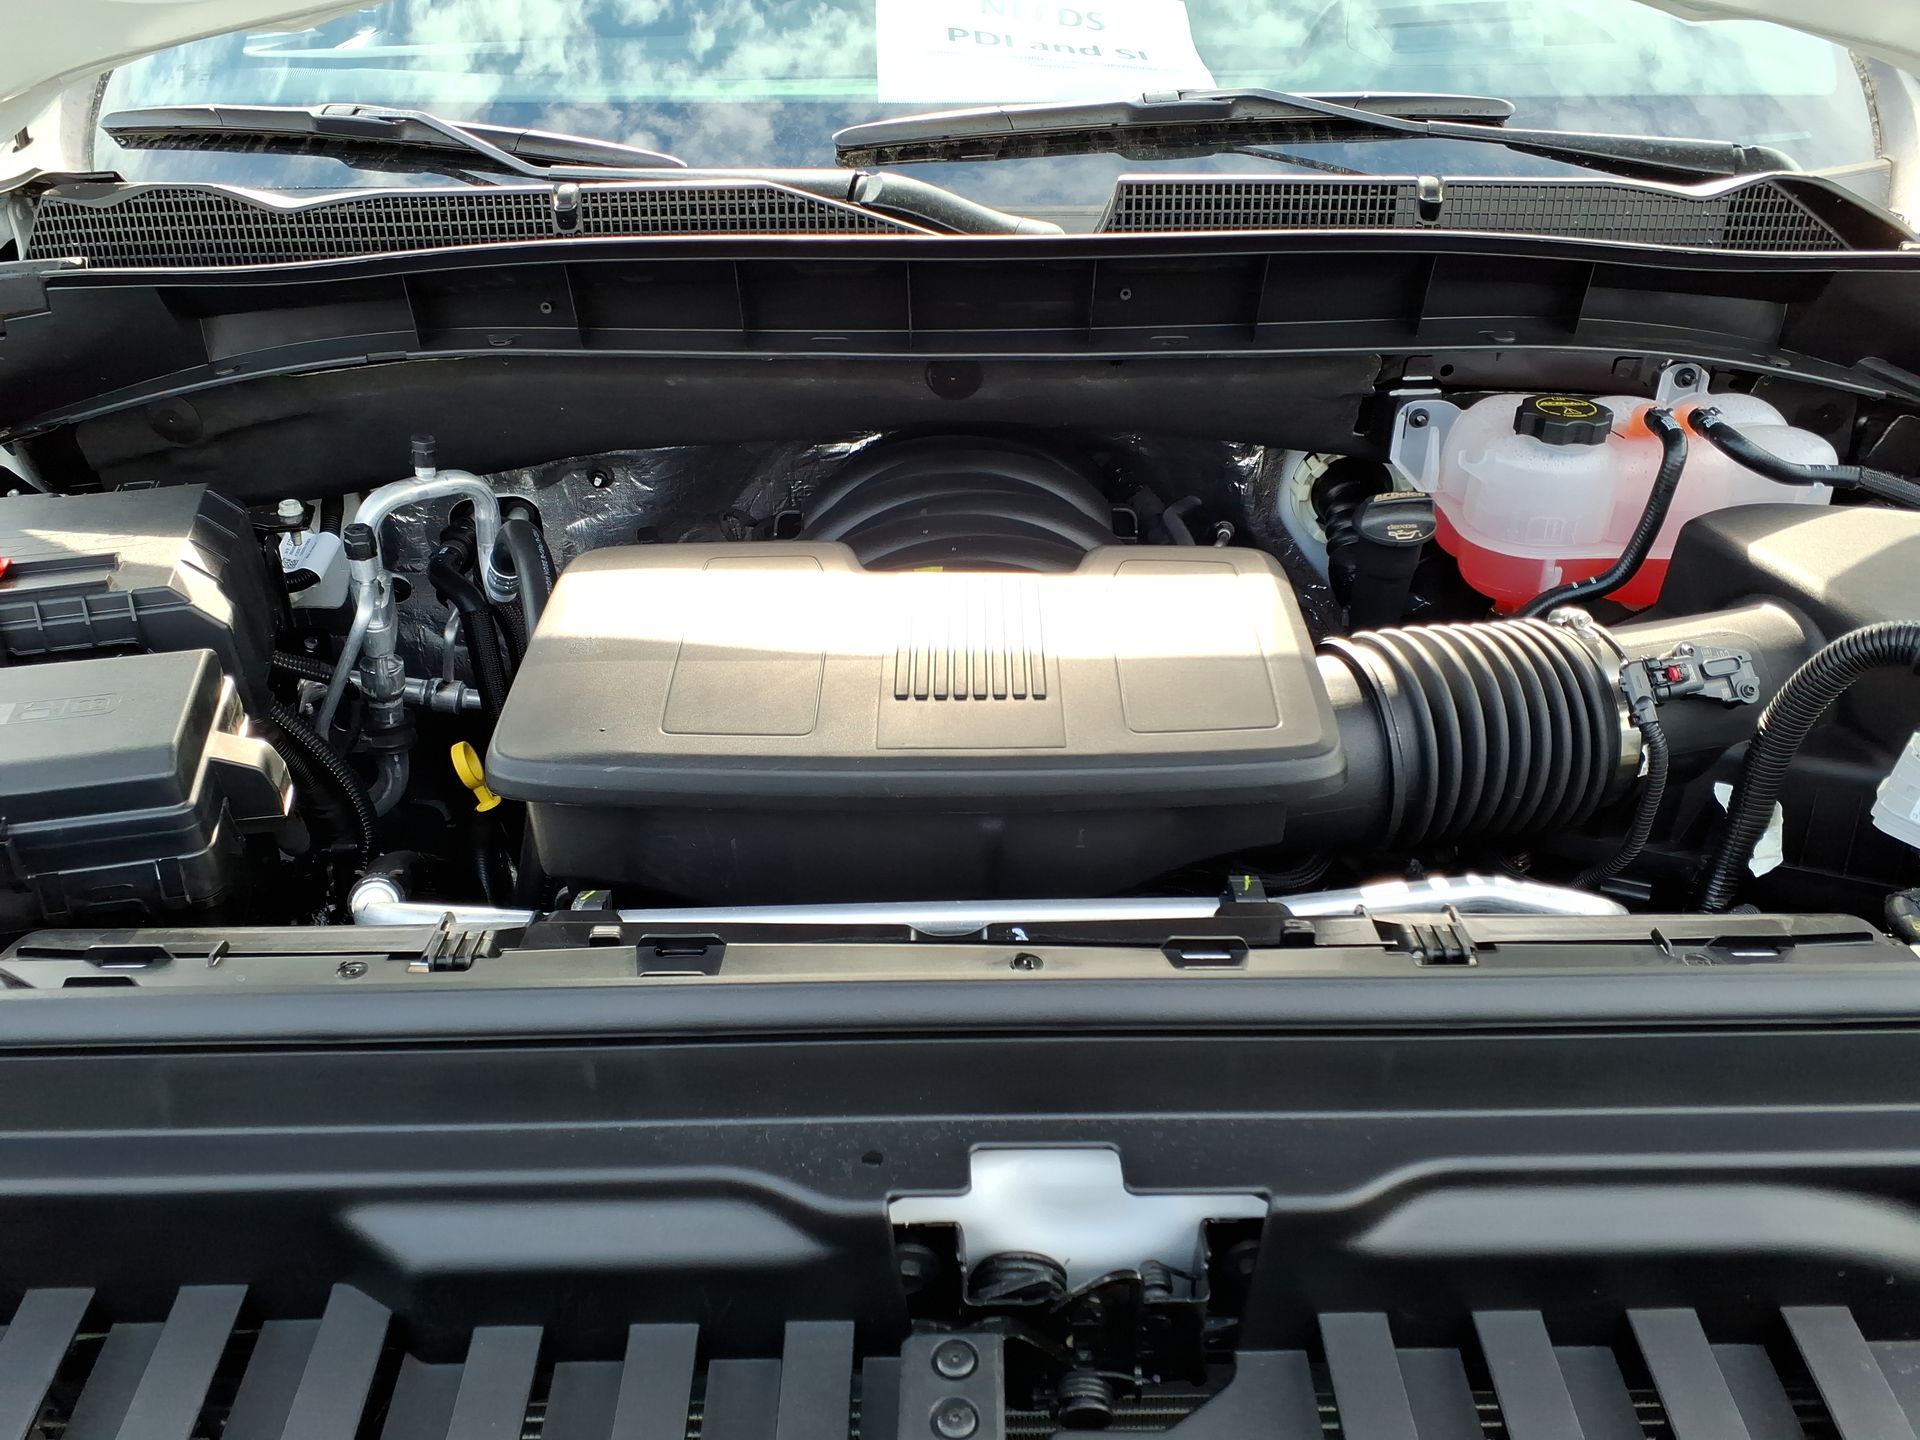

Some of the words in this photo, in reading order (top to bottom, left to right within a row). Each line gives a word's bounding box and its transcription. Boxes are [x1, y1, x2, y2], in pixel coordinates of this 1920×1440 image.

[980, 0, 1106, 31] NDS
[947, 27, 1014, 48] PDI
[1029, 41, 1102, 57] and
[1374, 491, 1426, 502] ACDelco
